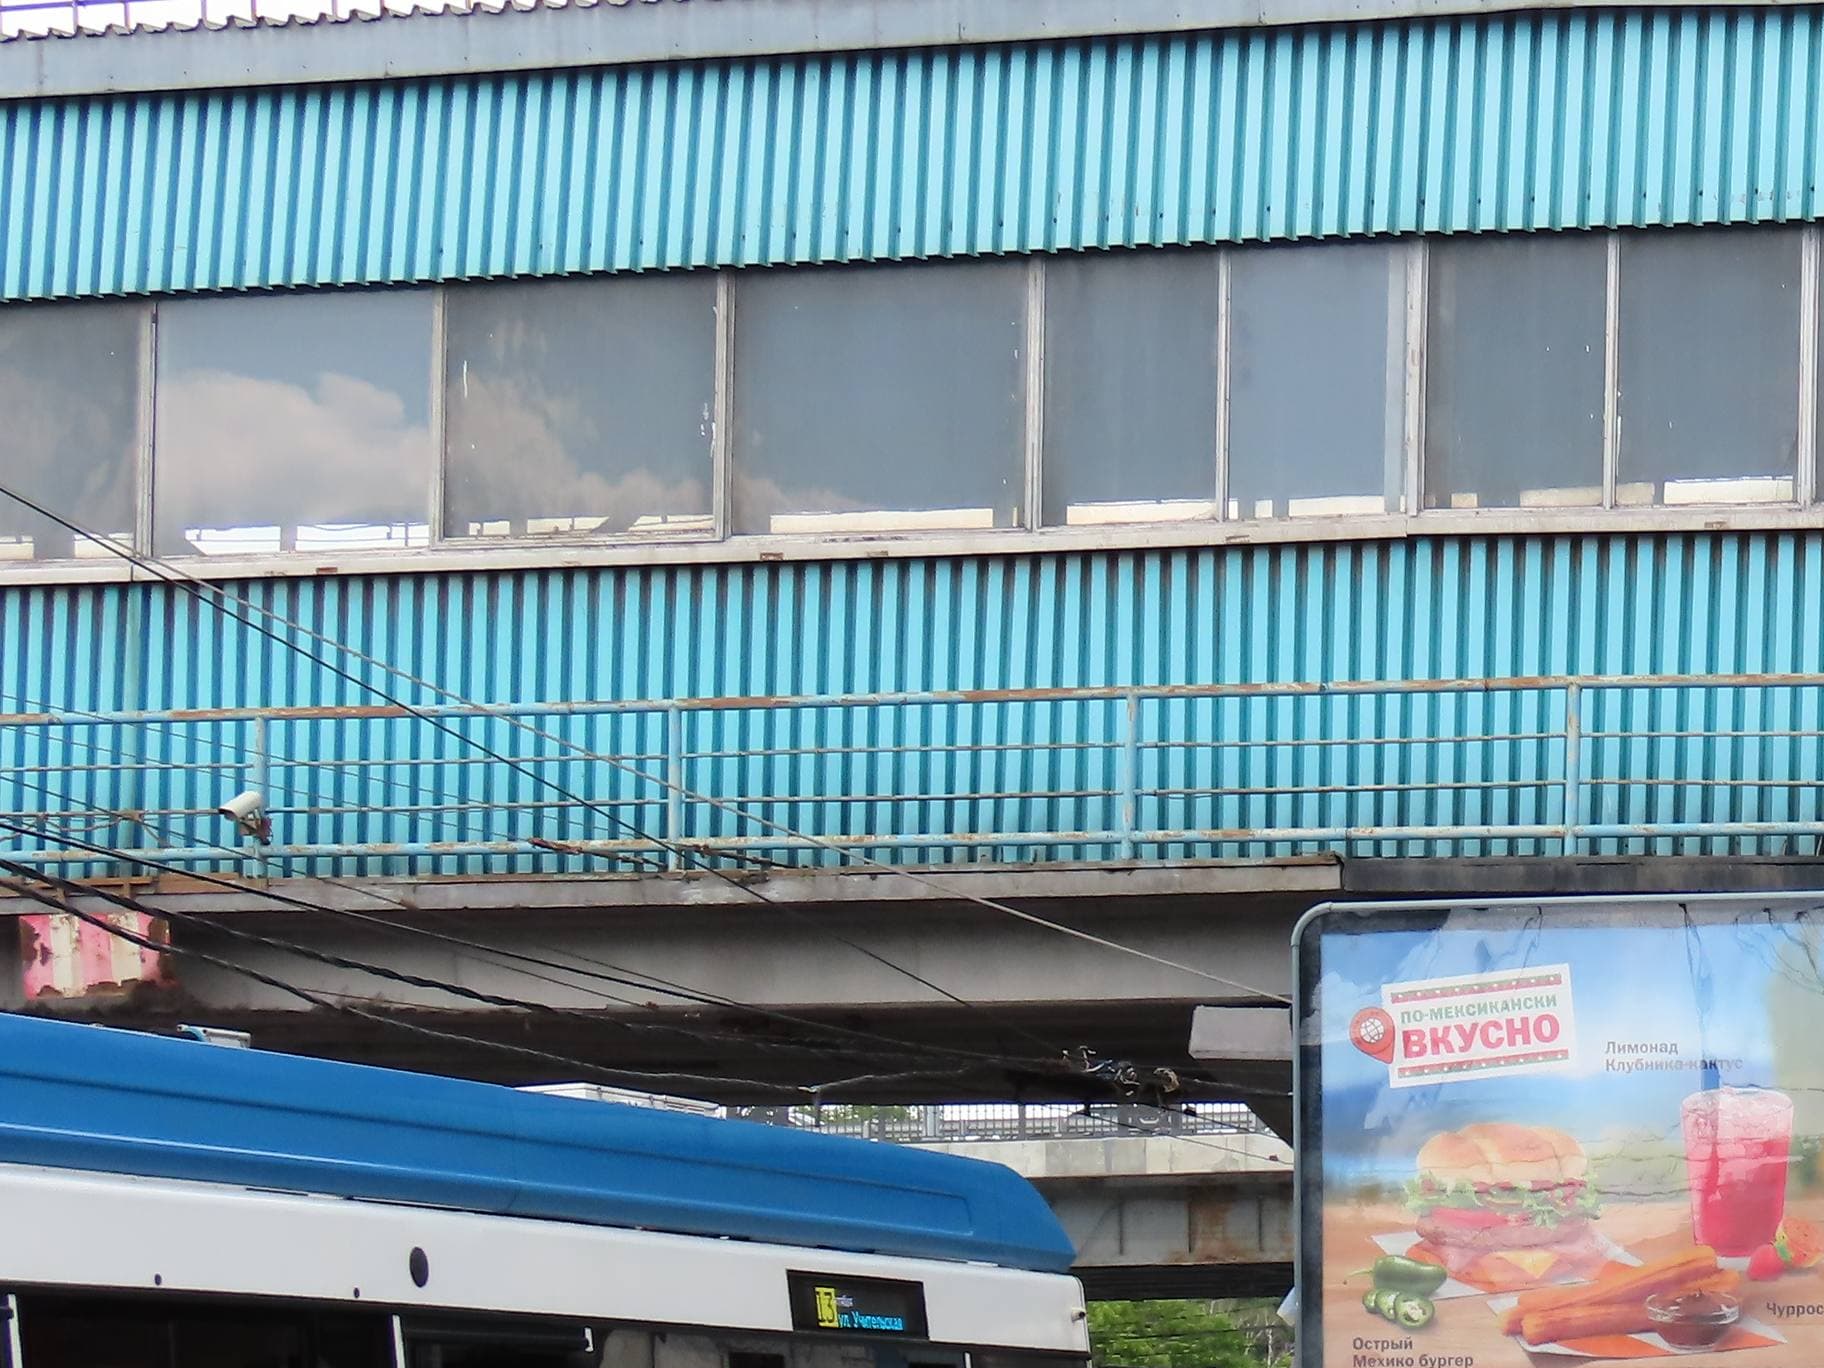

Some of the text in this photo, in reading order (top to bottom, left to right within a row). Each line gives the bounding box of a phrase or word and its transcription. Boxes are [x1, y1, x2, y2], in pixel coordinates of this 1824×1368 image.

[1401, 995, 1557, 1024] ПО-МЕКСИКАНСКИ
[1402, 1014, 1560, 1059] ВКУСНО
[1605, 1041, 1679, 1055] Лимонад
[1605, 1058, 1744, 1073] Клубника-кактус
[1766, 1301, 1824, 1318] Чуррос
[1352, 1337, 1413, 1351] Острый
[1352, 1354, 1414, 1368] Мехико
